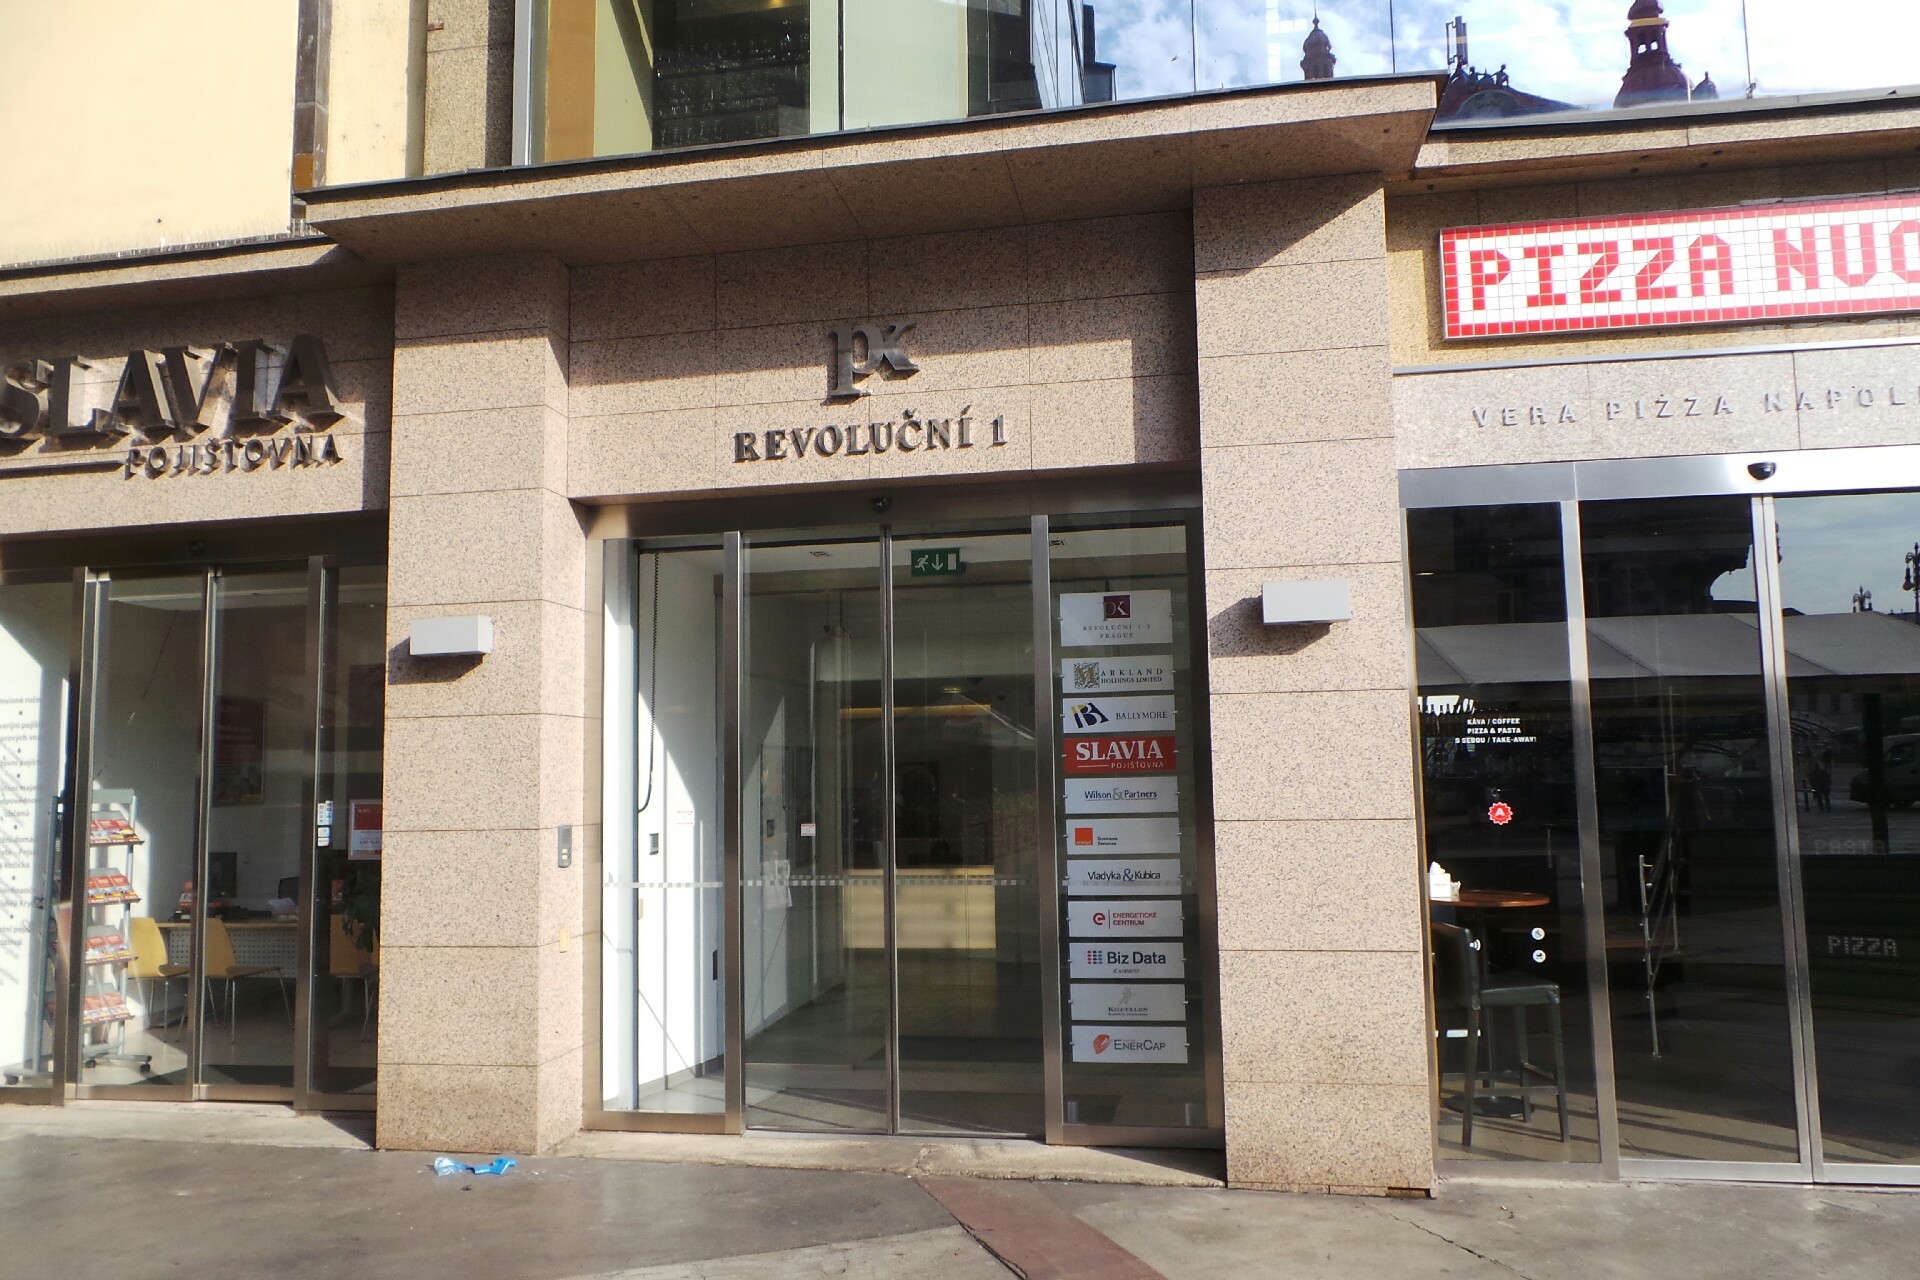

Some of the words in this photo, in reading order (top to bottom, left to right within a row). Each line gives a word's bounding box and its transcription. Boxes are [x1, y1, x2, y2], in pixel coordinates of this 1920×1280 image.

[1470, 234, 1735, 311] PIZZA
[0, 334, 345, 440] SLAVIA
[1472, 403, 1578, 428] VERA
[1607, 396, 1734, 421] PIZZA
[1765, 386, 1920, 413] NAPOL
[735, 405, 973, 462] REVOLUČNÍ
[989, 415, 1007, 447] 1
[1136, 676, 1163, 684] LIMITED
[1116, 712, 1168, 720] BALLYMORE
[1467, 717, 1486, 725] KÁVA
[1076, 739, 1164, 761] SLAVIA
[1084, 789, 1112, 799] Wilson
[1124, 789, 1158, 799] Partners
[1134, 870, 1161, 880] Kubica
[1112, 911, 1158, 919] ENERGETICKÉ
[1827, 935, 1898, 957] PIZZA
[1107, 952, 1129, 965] Biz
[1132, 951, 1166, 965] Data
